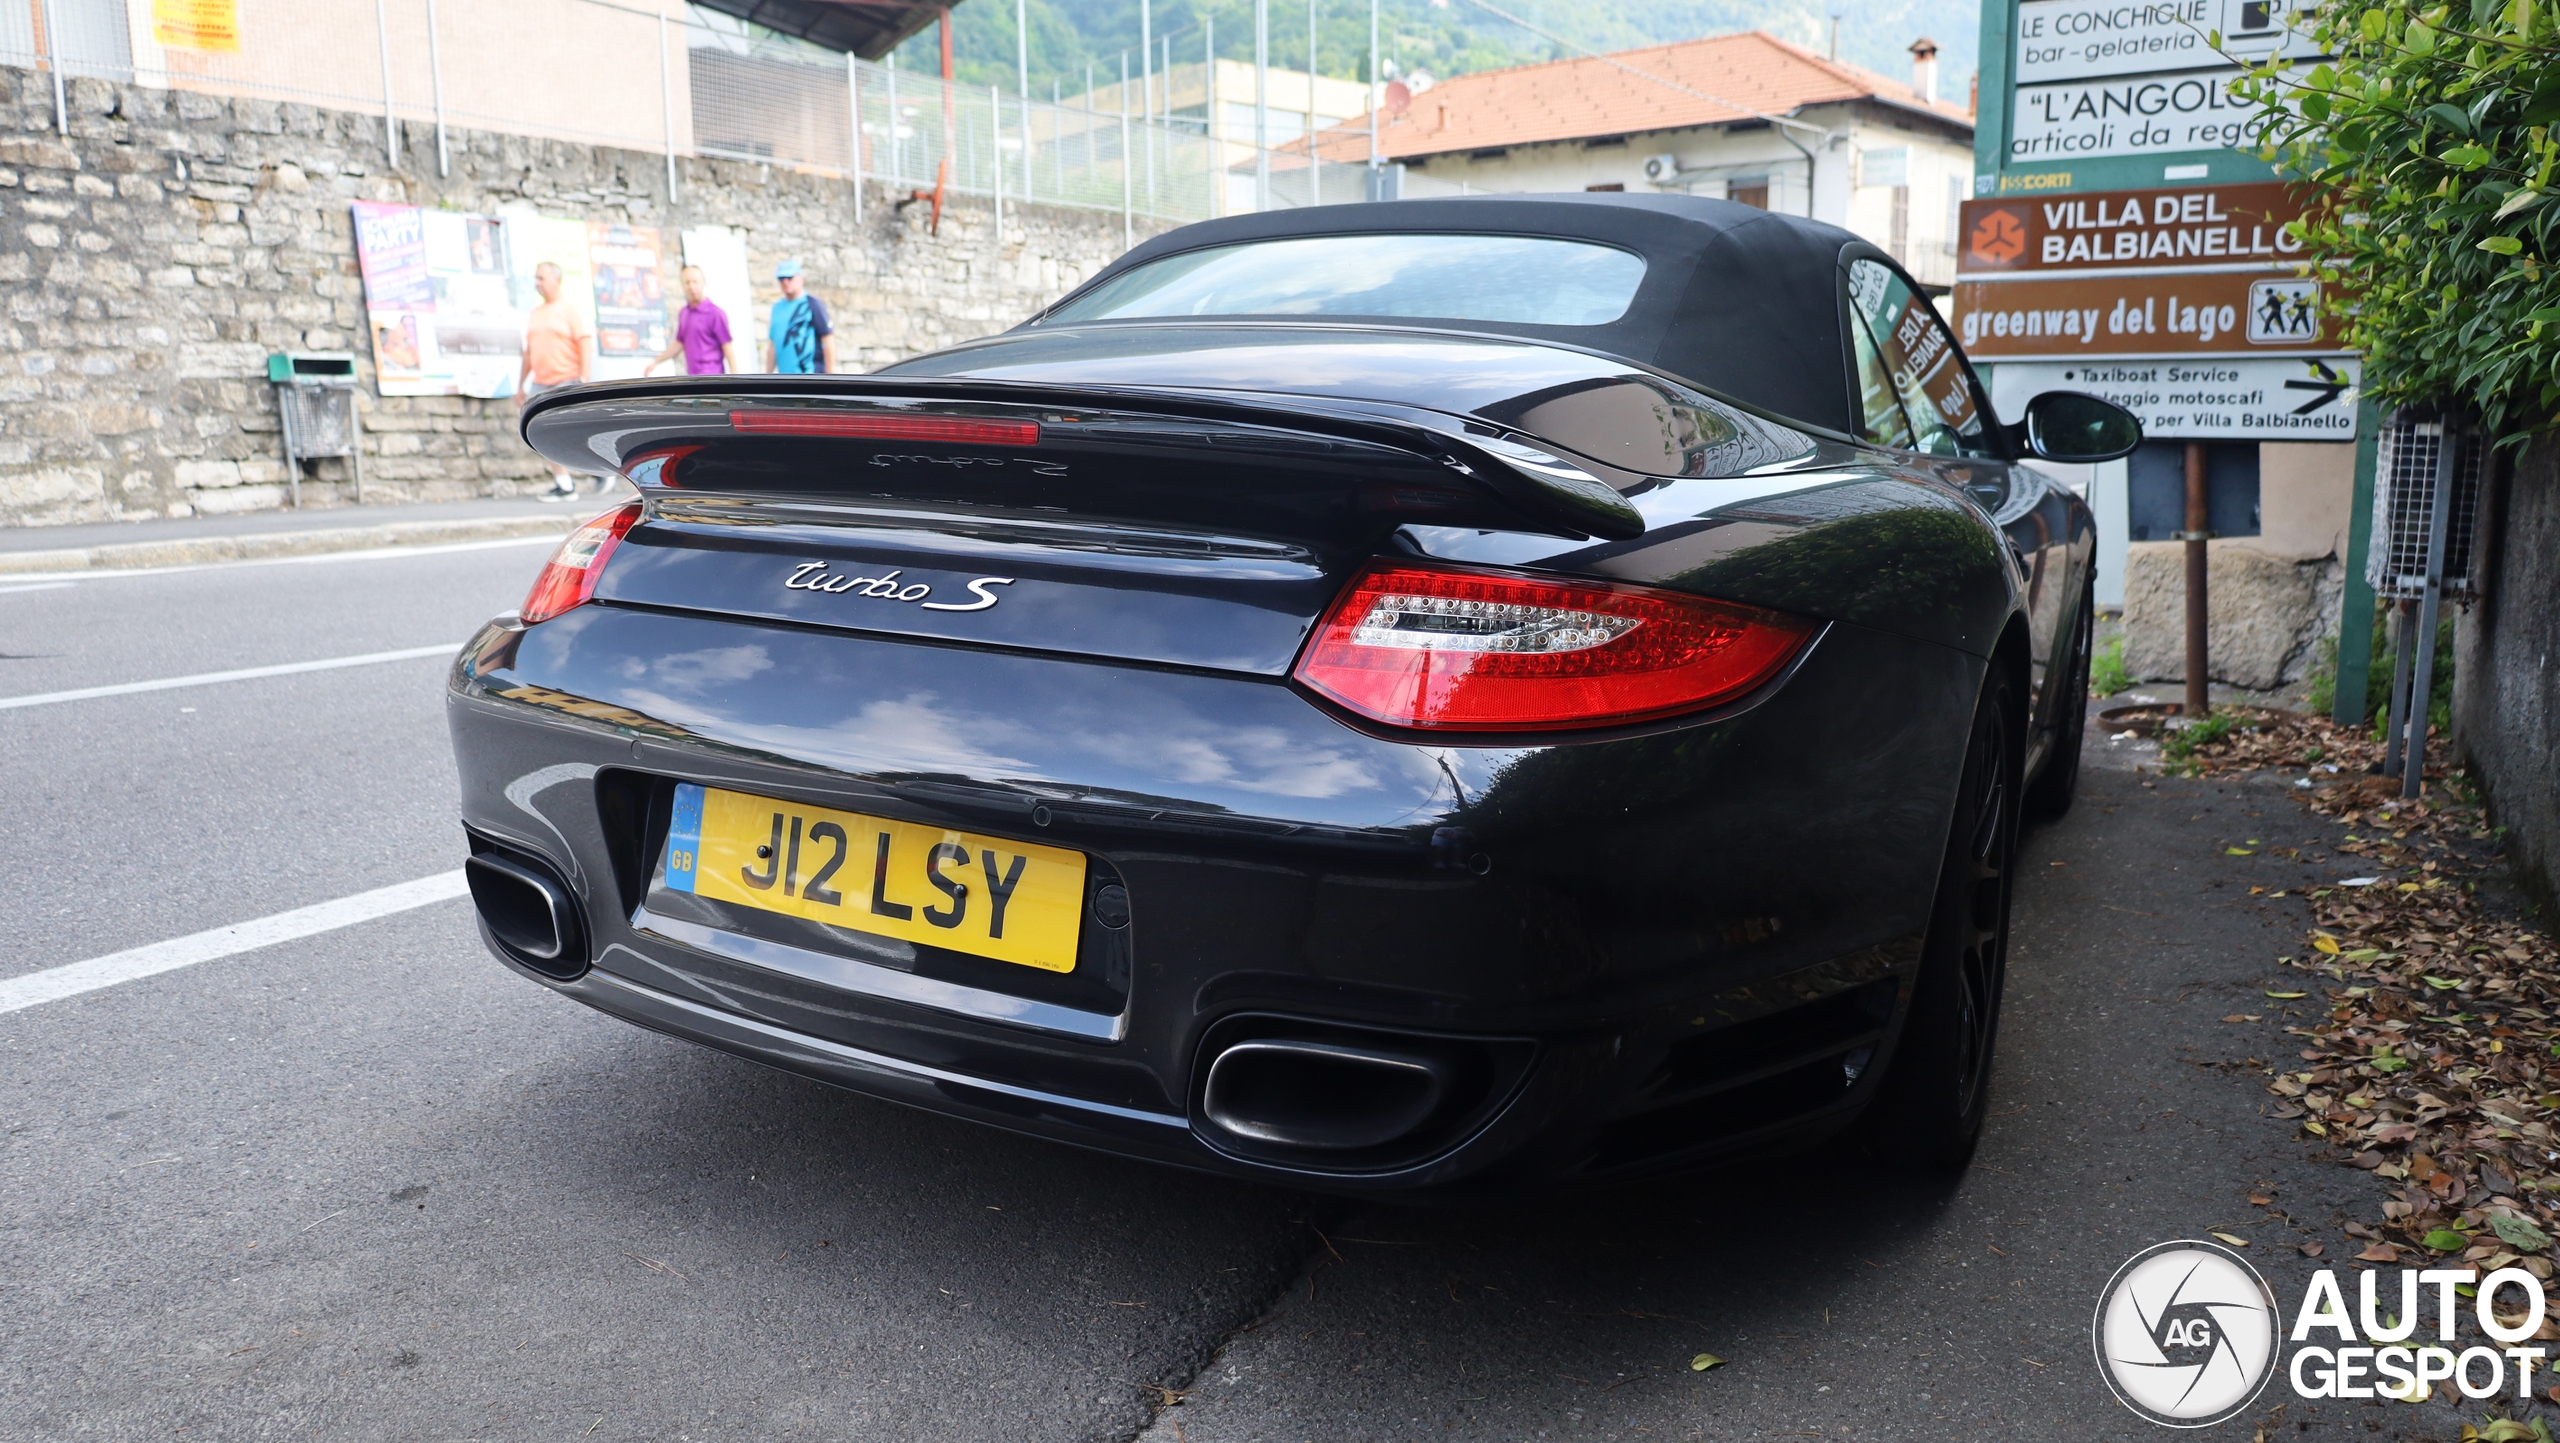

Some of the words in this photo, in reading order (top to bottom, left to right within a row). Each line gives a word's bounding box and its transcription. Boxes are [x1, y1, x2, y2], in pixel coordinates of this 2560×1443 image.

[2021, 17, 2044, 39] LE
[2055, 0, 2206, 36] CONCHIGLIE
[2025, 46, 2065, 64] bar
[2084, 31, 2195, 62] gelateria
[2011, 124, 2113, 154] articoli
[2130, 120, 2169, 146] da
[2043, 198, 2144, 230] VILLA
[2155, 194, 2227, 225] DEL
[363, 223, 419, 254] PARTY
[2041, 226, 2303, 263] BALBIANELLO
[1962, 307, 2099, 346] greenway
[2108, 297, 2156, 335] del
[2168, 296, 2236, 342] lago
[2081, 367, 2157, 383] Taxiboat
[2168, 367, 2239, 382] Service
[2099, 390, 2159, 407] leggio
[2168, 390, 2262, 405] motoscafi
[2155, 415, 2184, 429] per
[2193, 413, 2231, 427] Villa
[2242, 413, 2350, 429] Balbianello
[784, 560, 931, 602] turbo
[921, 577, 1016, 612] S
[671, 849, 693, 874] GB
[741, 812, 848, 907] J12
[870, 831, 1027, 940] LSY
